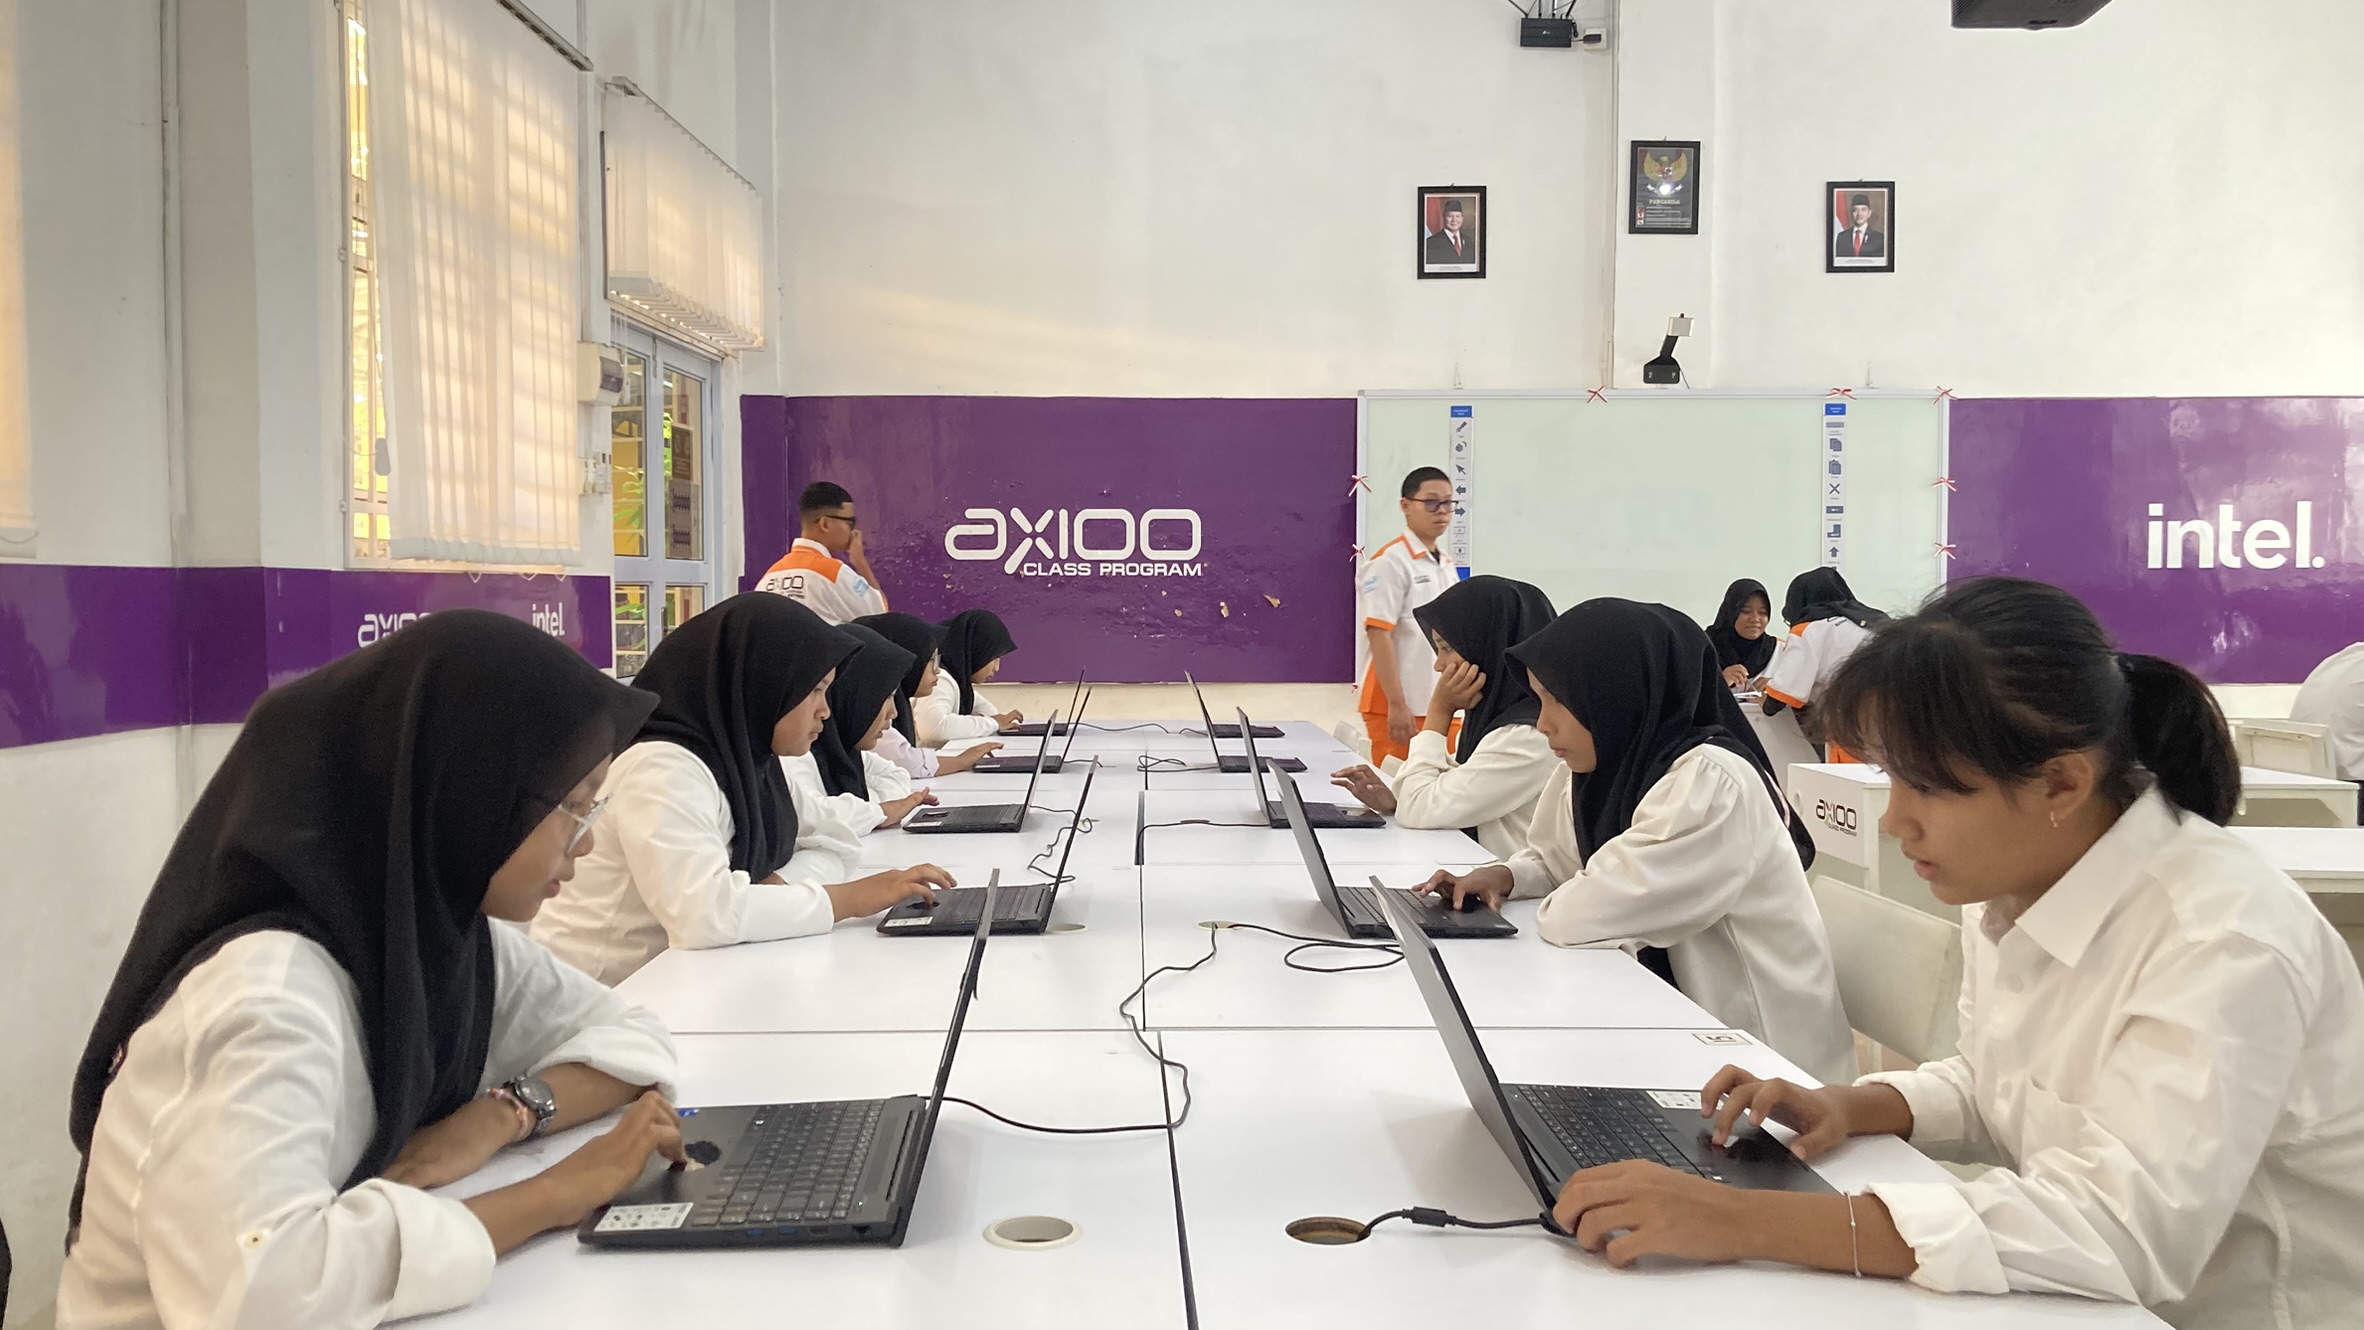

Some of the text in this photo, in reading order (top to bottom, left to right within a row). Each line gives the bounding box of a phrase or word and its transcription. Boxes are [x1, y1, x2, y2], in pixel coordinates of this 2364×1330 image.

[2148, 501, 2326, 569] intel.
[1022, 562, 1202, 577] CLASS PROGRAM
